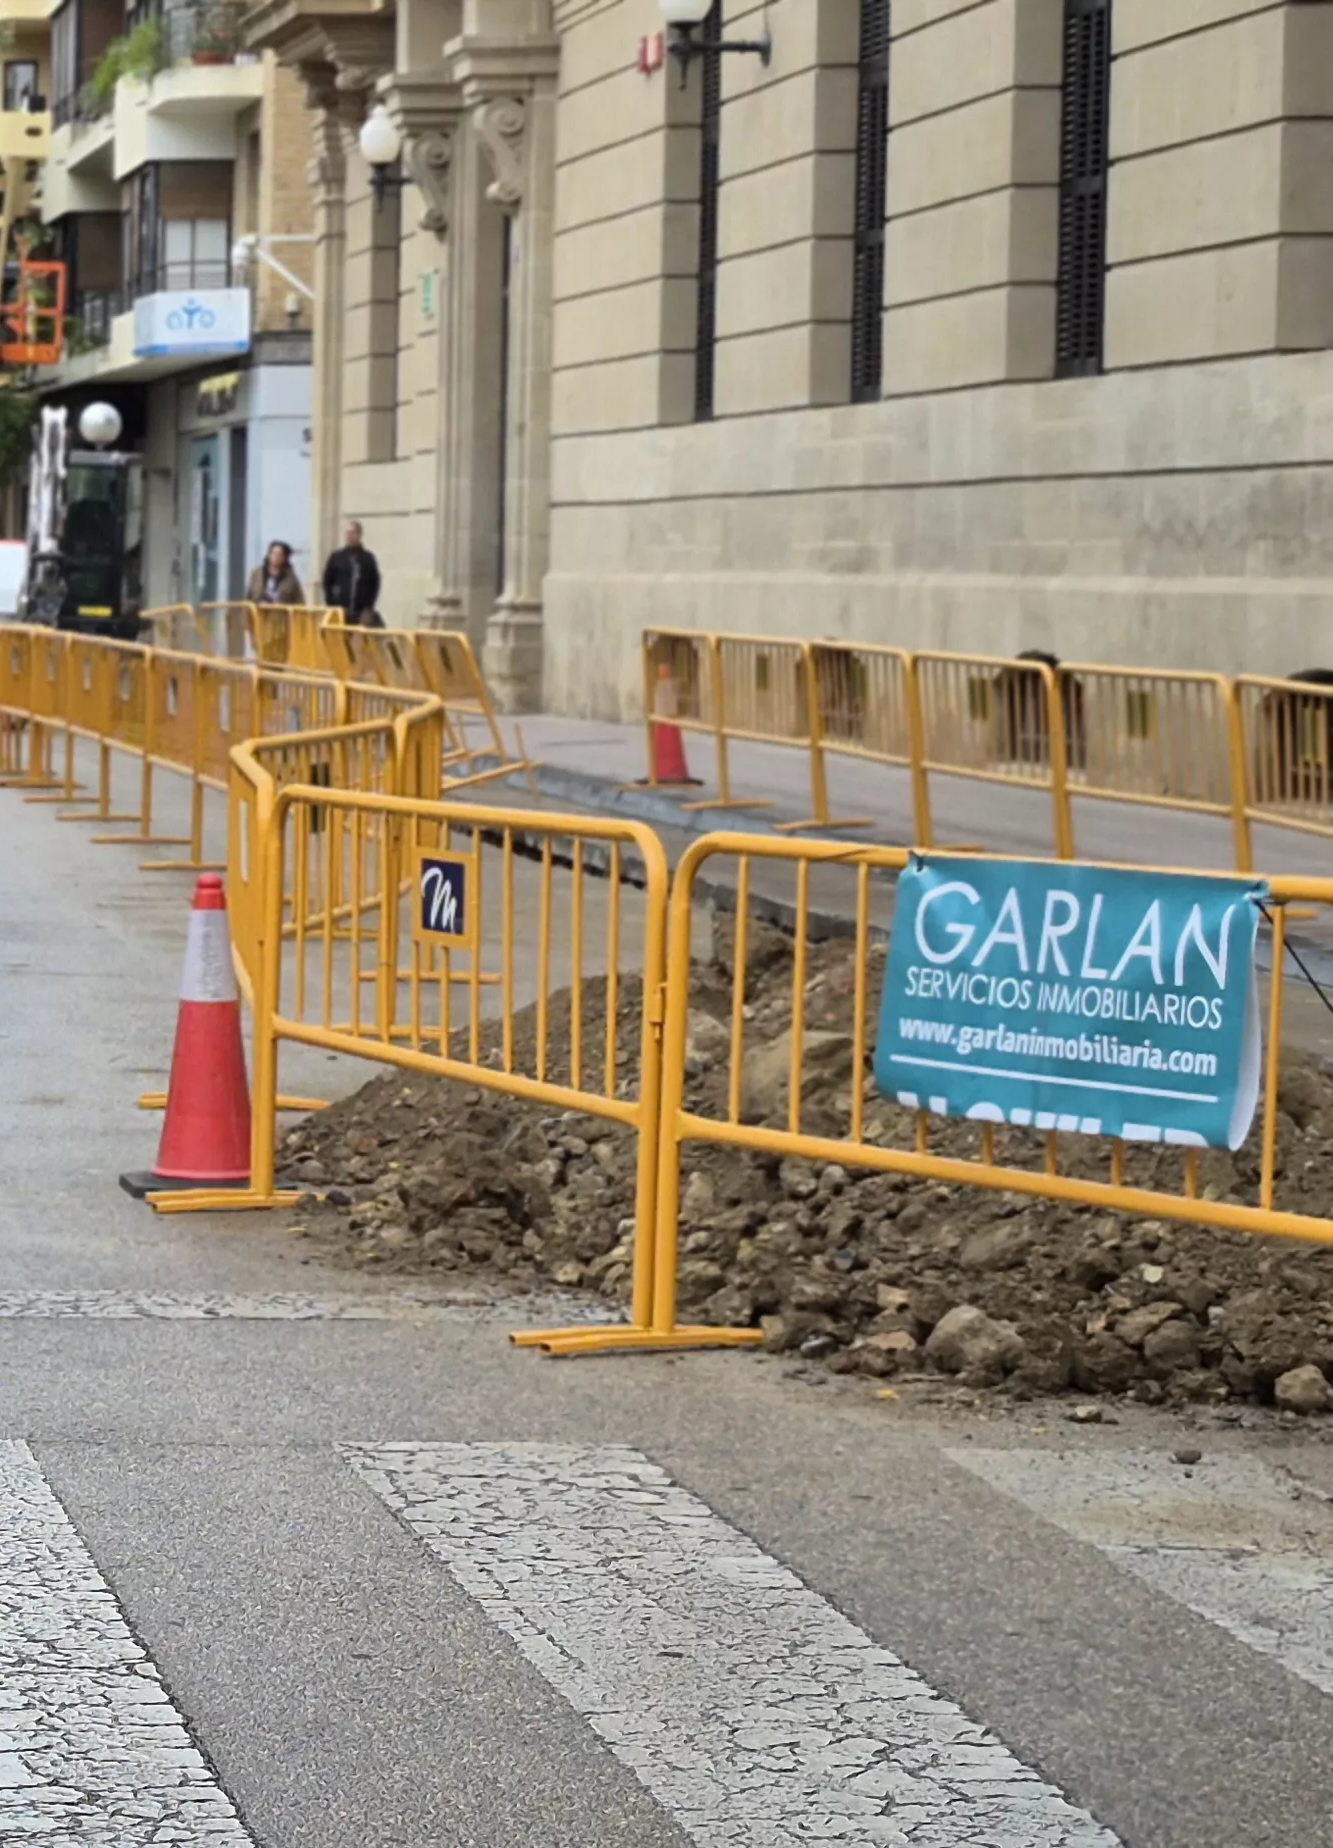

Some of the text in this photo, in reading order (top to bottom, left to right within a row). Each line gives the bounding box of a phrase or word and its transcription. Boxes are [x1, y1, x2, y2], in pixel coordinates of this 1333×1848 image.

[915, 881, 1237, 990] GARLAN
[904, 965, 1223, 1030] SERVICIOS INMOBILIARIOS
[898, 1016, 1218, 1077] www.garlaninmobiliaria.com
